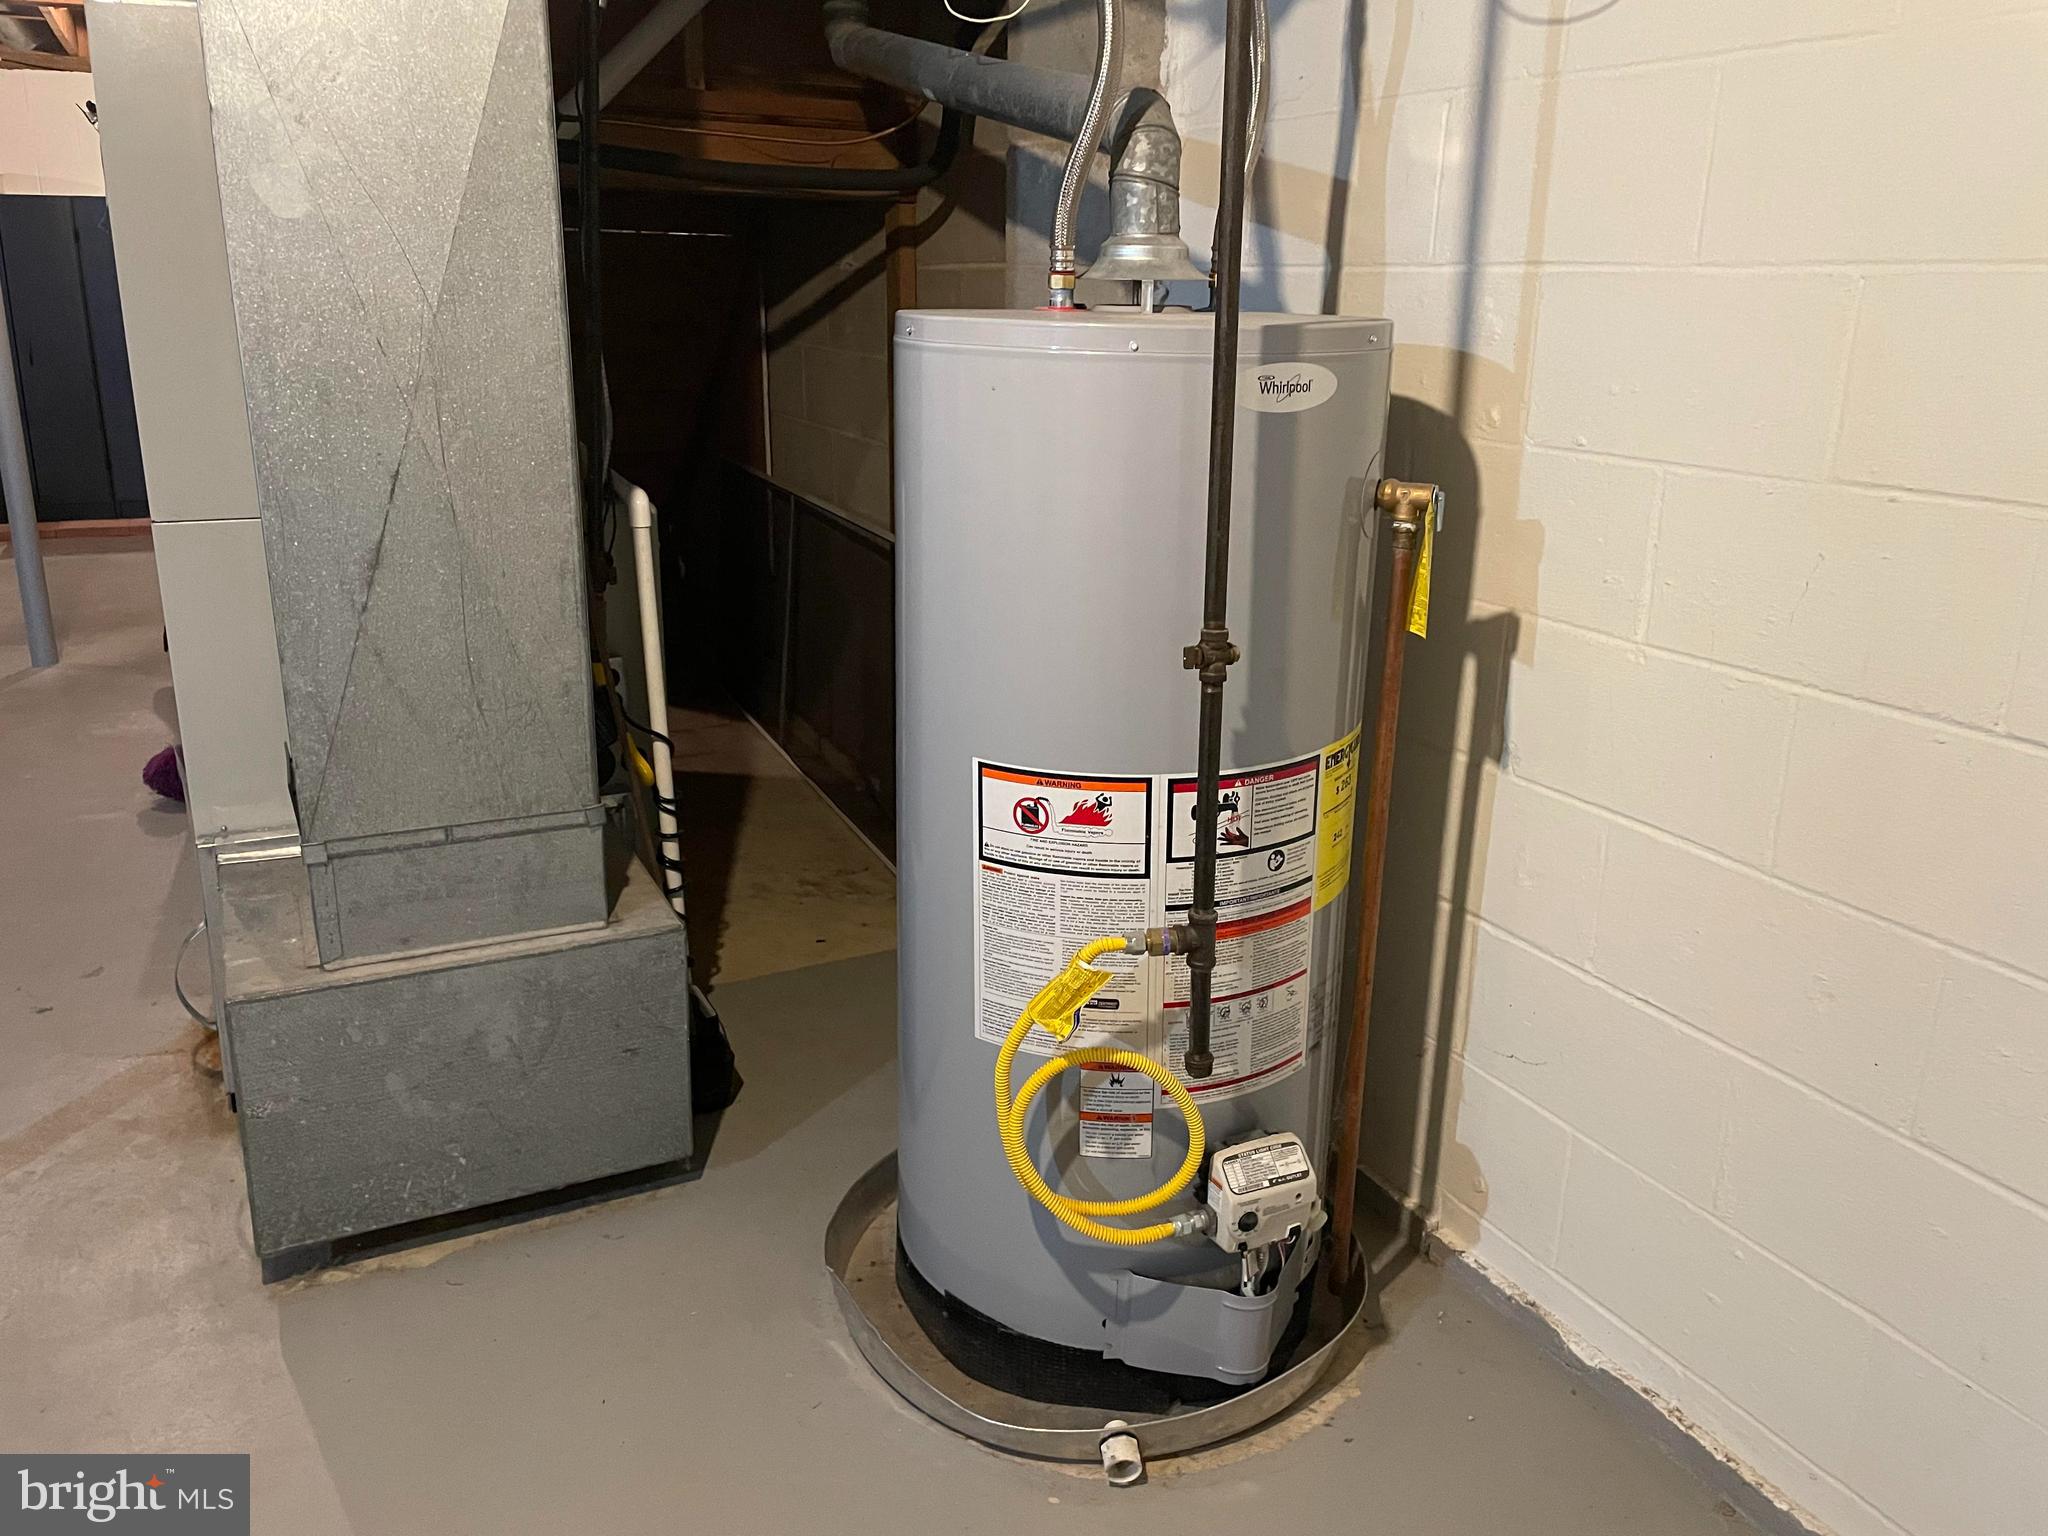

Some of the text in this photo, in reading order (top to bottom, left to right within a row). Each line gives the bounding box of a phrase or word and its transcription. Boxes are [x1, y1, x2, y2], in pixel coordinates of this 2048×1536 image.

[1259, 379, 1311, 398] Whirlpool
[1044, 779, 1082, 790] WARNING
[1244, 774, 1274, 787] DANGER
[1227, 814, 1241, 823] HOT
